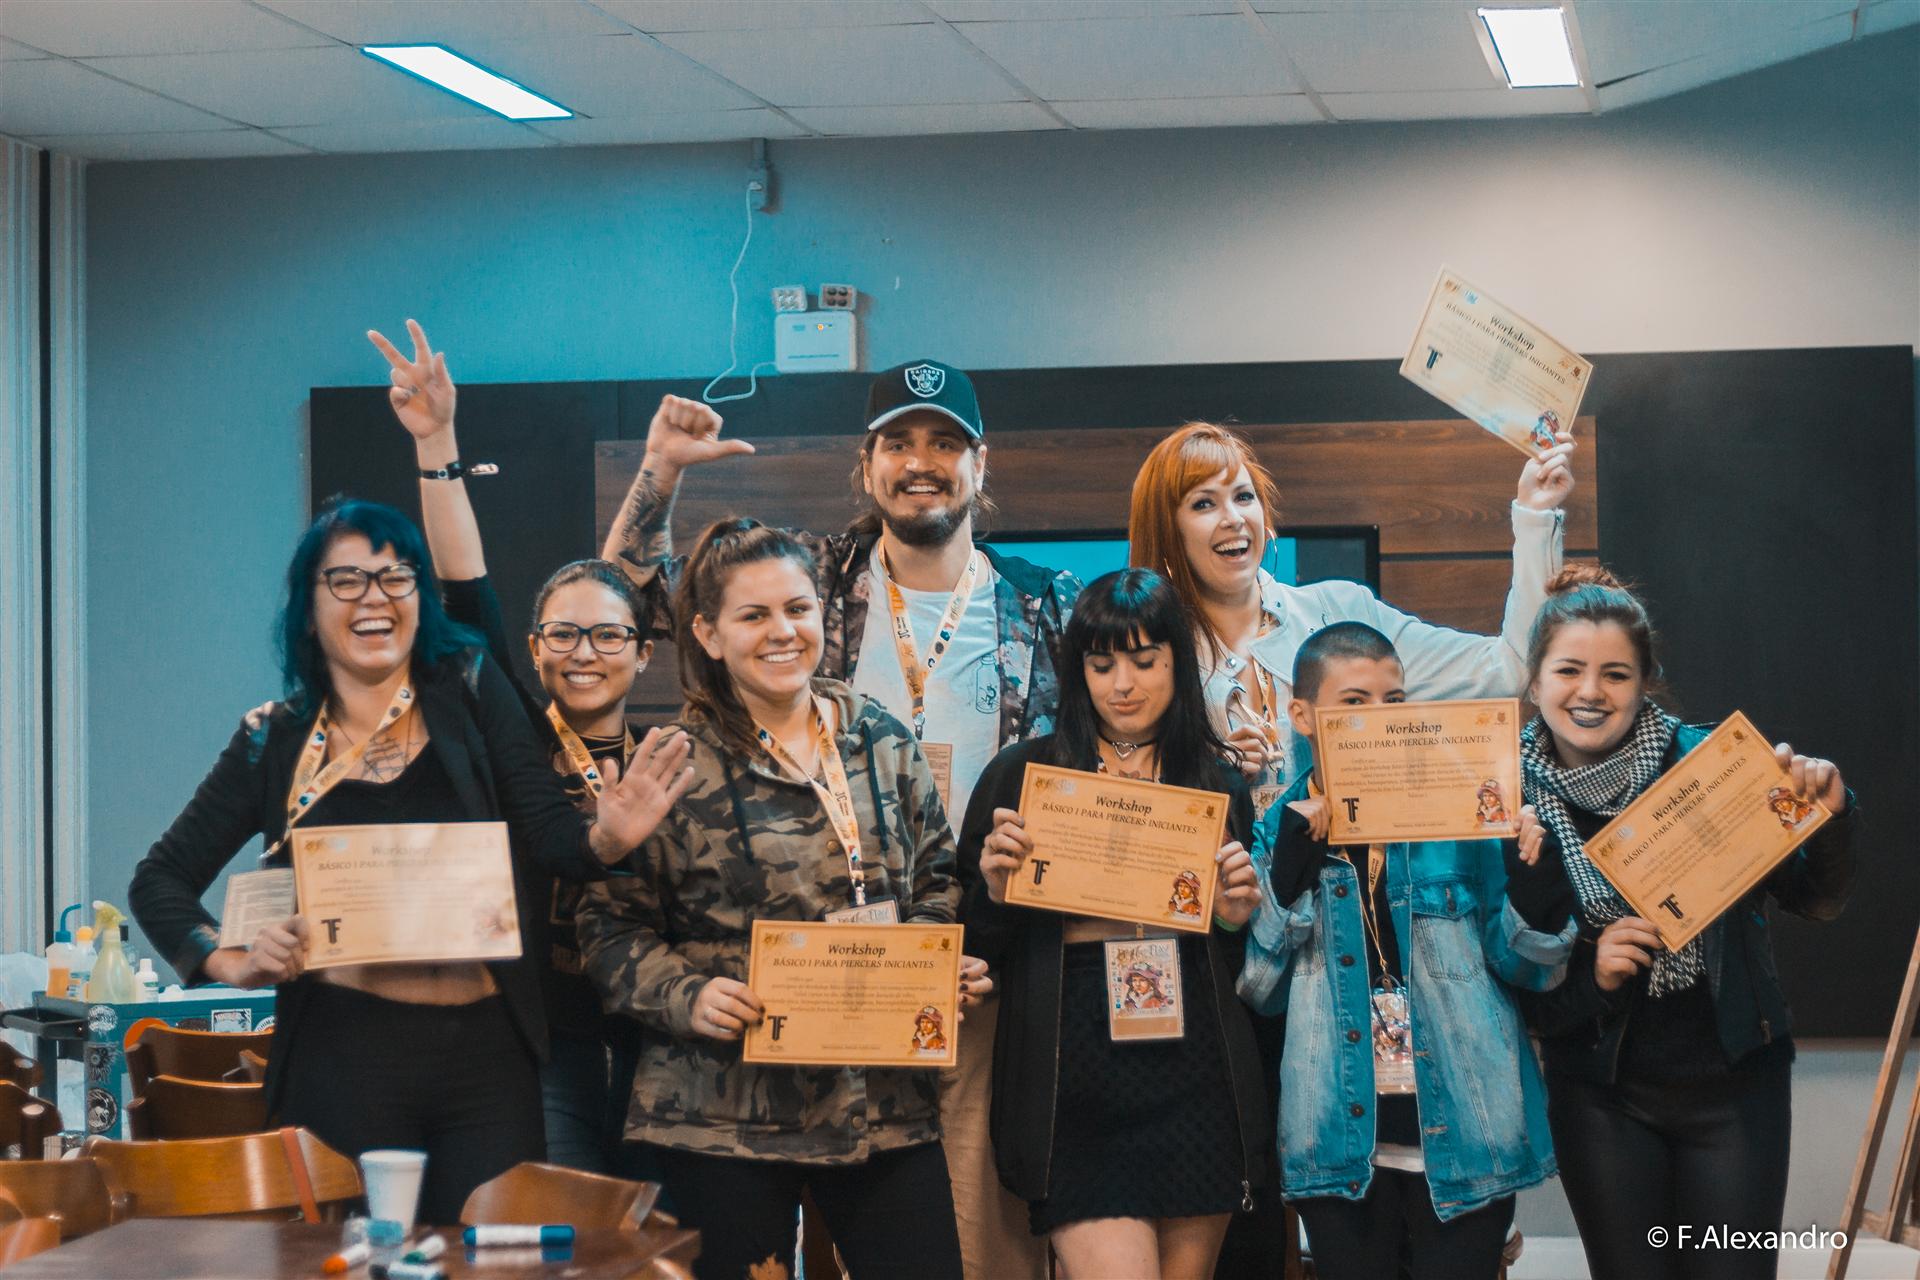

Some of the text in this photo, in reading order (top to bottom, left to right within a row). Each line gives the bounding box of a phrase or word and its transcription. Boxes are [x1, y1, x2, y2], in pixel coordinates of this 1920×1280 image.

[1490, 316, 1535, 351] Workshop
[1529, 355, 1566, 385] INICIANTES
[1385, 721, 1442, 736] Workshop
[1338, 739, 1366, 750] BÁSICO
[1374, 739, 1396, 748] PARA
[1399, 737, 1439, 747] PIERCERS
[1441, 735, 1492, 745] INICIANTES
[1096, 795, 1152, 818] Workshop
[1623, 841, 1649, 866] BÁSICO
[1652, 821, 1674, 841] PARA
[1672, 792, 1706, 824] PIERCERS
[1707, 757, 1747, 793] INICIANTES
[1652, 778, 1702, 822] Workshop
[1042, 801, 1073, 815] BÁSICO
[1080, 808, 1104, 820] PARA
[1106, 813, 1147, 826] PIERCERS
[1148, 819, 1198, 834] INICIANTES
[318, 859, 351, 871] BÁSICO
[828, 942, 886, 957] Workshop
[773, 957, 806, 968] BÁSICO
[814, 959, 838, 968] PARA
[841, 960, 881, 968] PIERCERS
[884, 960, 934, 969] INICIANTES
